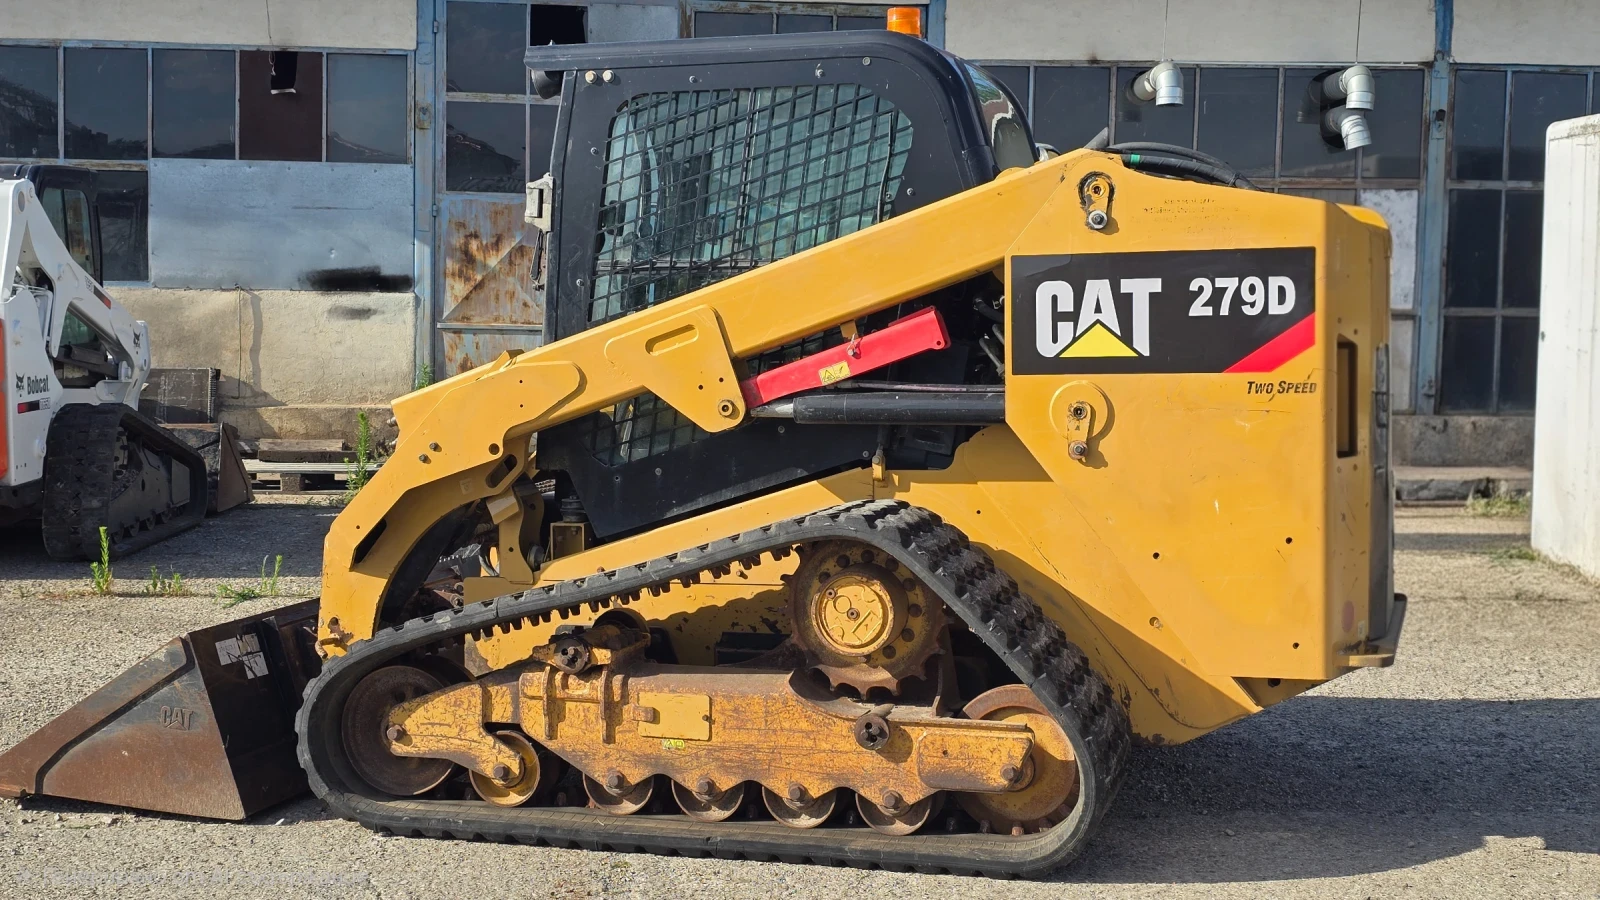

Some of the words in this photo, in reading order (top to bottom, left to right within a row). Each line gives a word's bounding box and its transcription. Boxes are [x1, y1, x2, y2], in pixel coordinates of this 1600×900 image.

[1035, 278, 1162, 358] CAT
[1188, 275, 1296, 316] 279D
[27, 375, 49, 395] Bobcat
[160, 705, 194, 730] CAT
